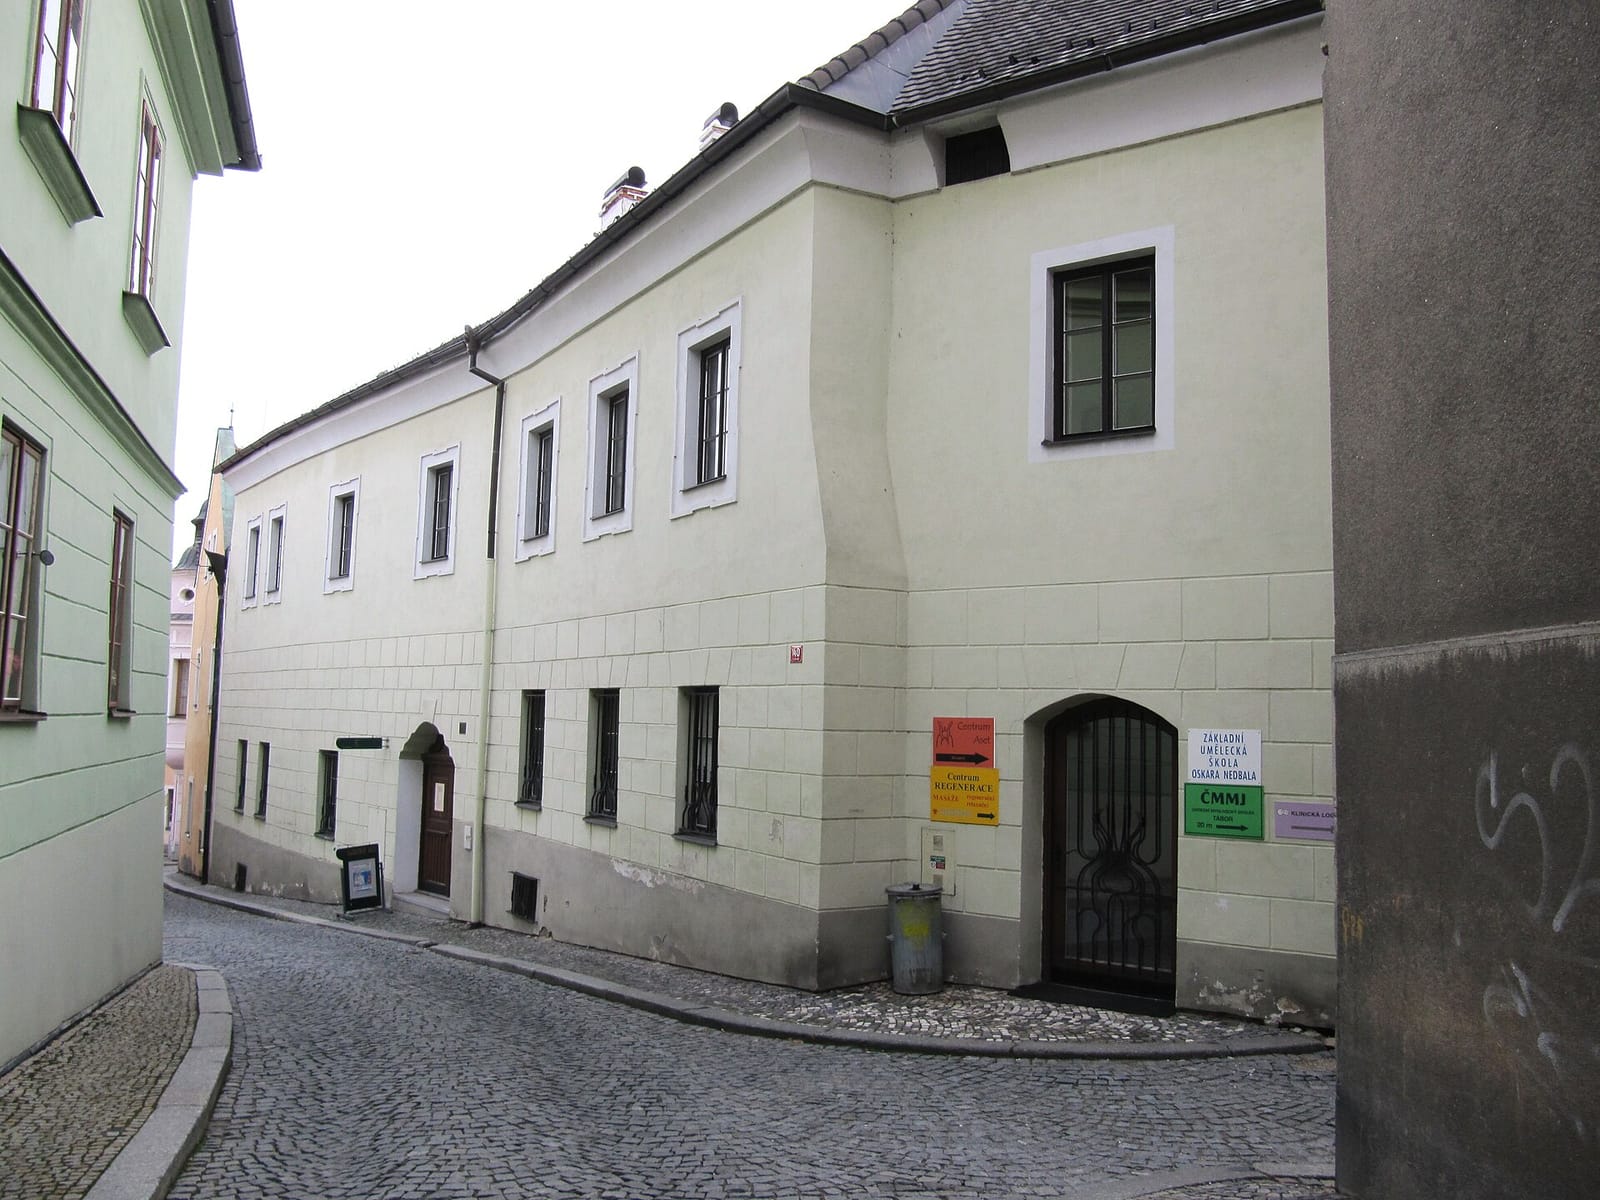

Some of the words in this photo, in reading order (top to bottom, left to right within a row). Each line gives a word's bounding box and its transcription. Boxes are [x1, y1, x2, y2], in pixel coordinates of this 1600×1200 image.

[957, 721, 991, 731] Centrum
[1203, 731, 1244, 744] ZÁKLADNÍ
[1200, 744, 1247, 756] UMĚLECKÁ
[1208, 756, 1239, 768] ŠKOLA
[947, 772, 980, 782] Centrum
[1191, 769, 1220, 780] OSKARA
[1223, 770, 1257, 781] NEDBALA
[934, 782, 994, 793] REGENERACE
[1200, 788, 1246, 806] ČMMJ
